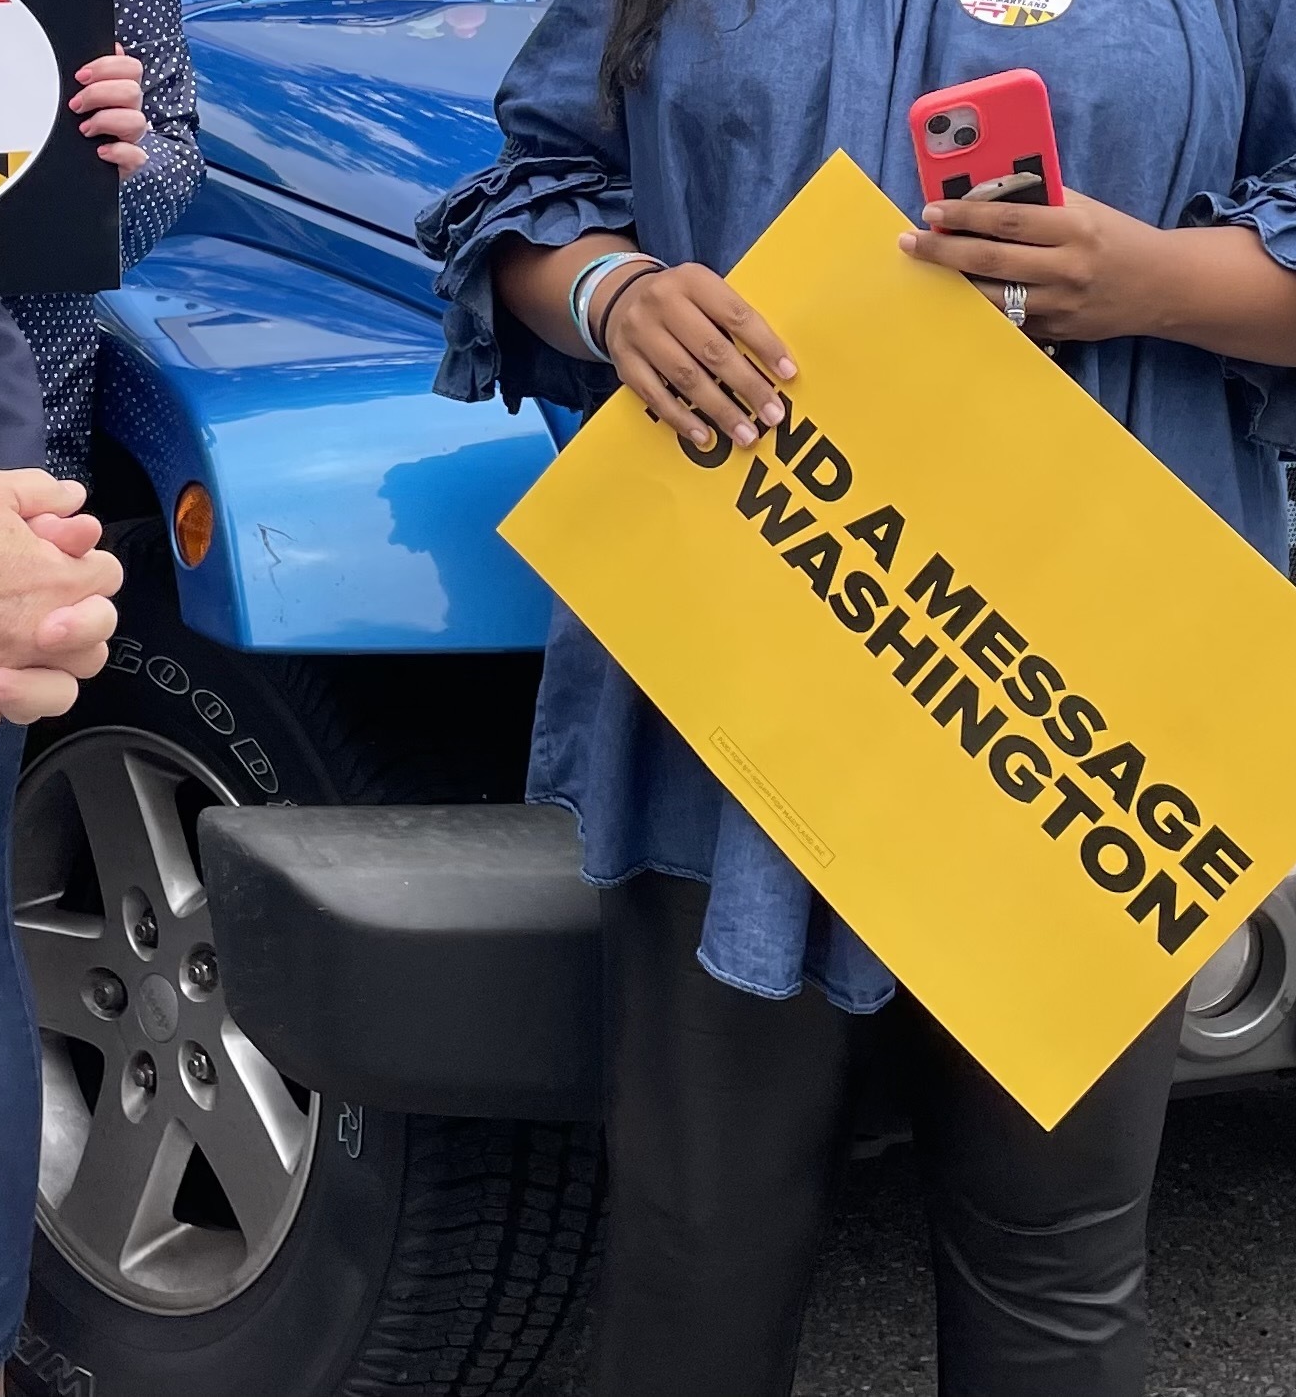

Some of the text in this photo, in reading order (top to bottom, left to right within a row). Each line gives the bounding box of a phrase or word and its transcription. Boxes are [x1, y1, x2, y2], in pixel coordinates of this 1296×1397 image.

[736, 455, 1210, 955] WASHINGTON
[844, 505, 905, 573] A
[905, 553, 1253, 900] MESSAGE
